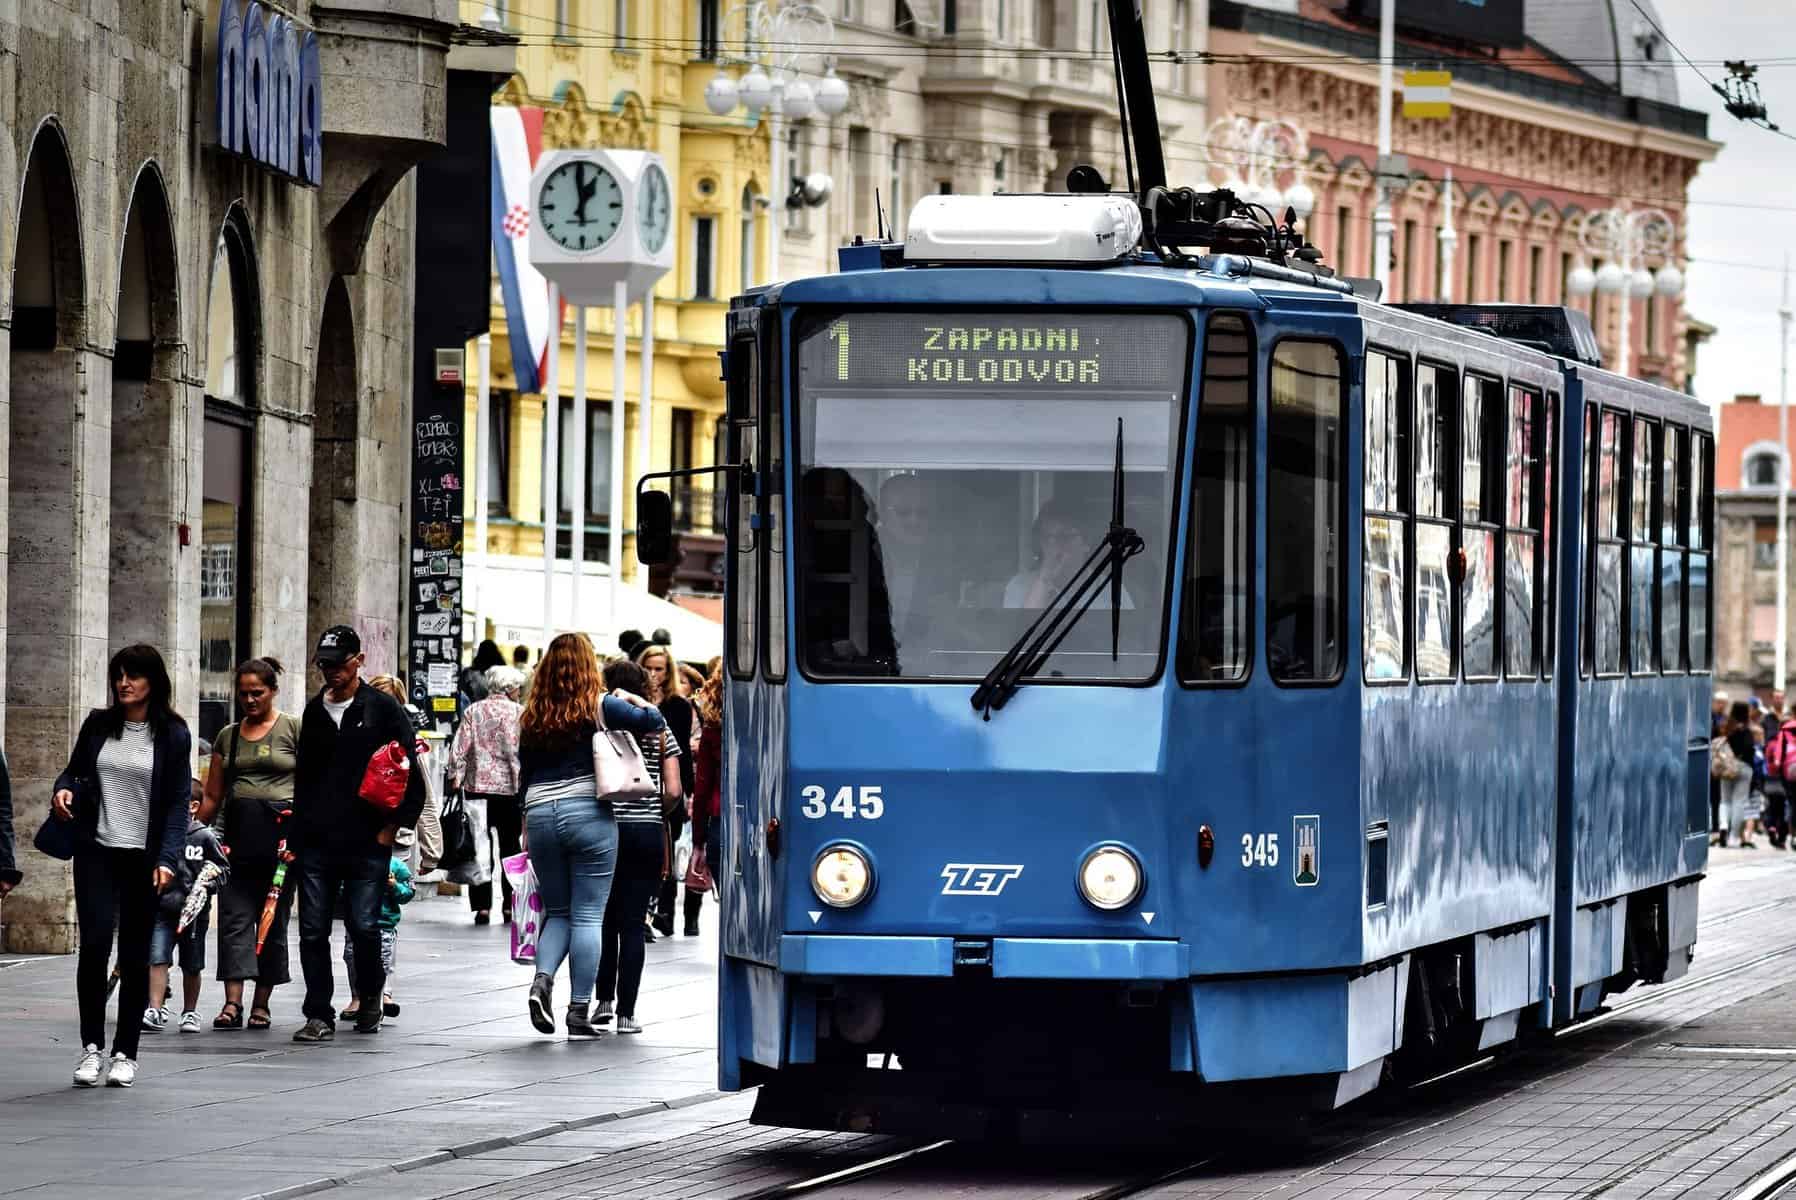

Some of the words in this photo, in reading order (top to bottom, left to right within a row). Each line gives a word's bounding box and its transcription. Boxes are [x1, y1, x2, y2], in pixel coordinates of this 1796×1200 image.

[830, 320, 849, 381] 1
[923, 327, 1080, 351] ZAPADNI
[907, 358, 1100, 383] KOLODVOR
[801, 784, 885, 820] 345
[184, 844, 204, 860] 02
[1241, 832, 1279, 867] 345
[940, 863, 1025, 896] ZET
